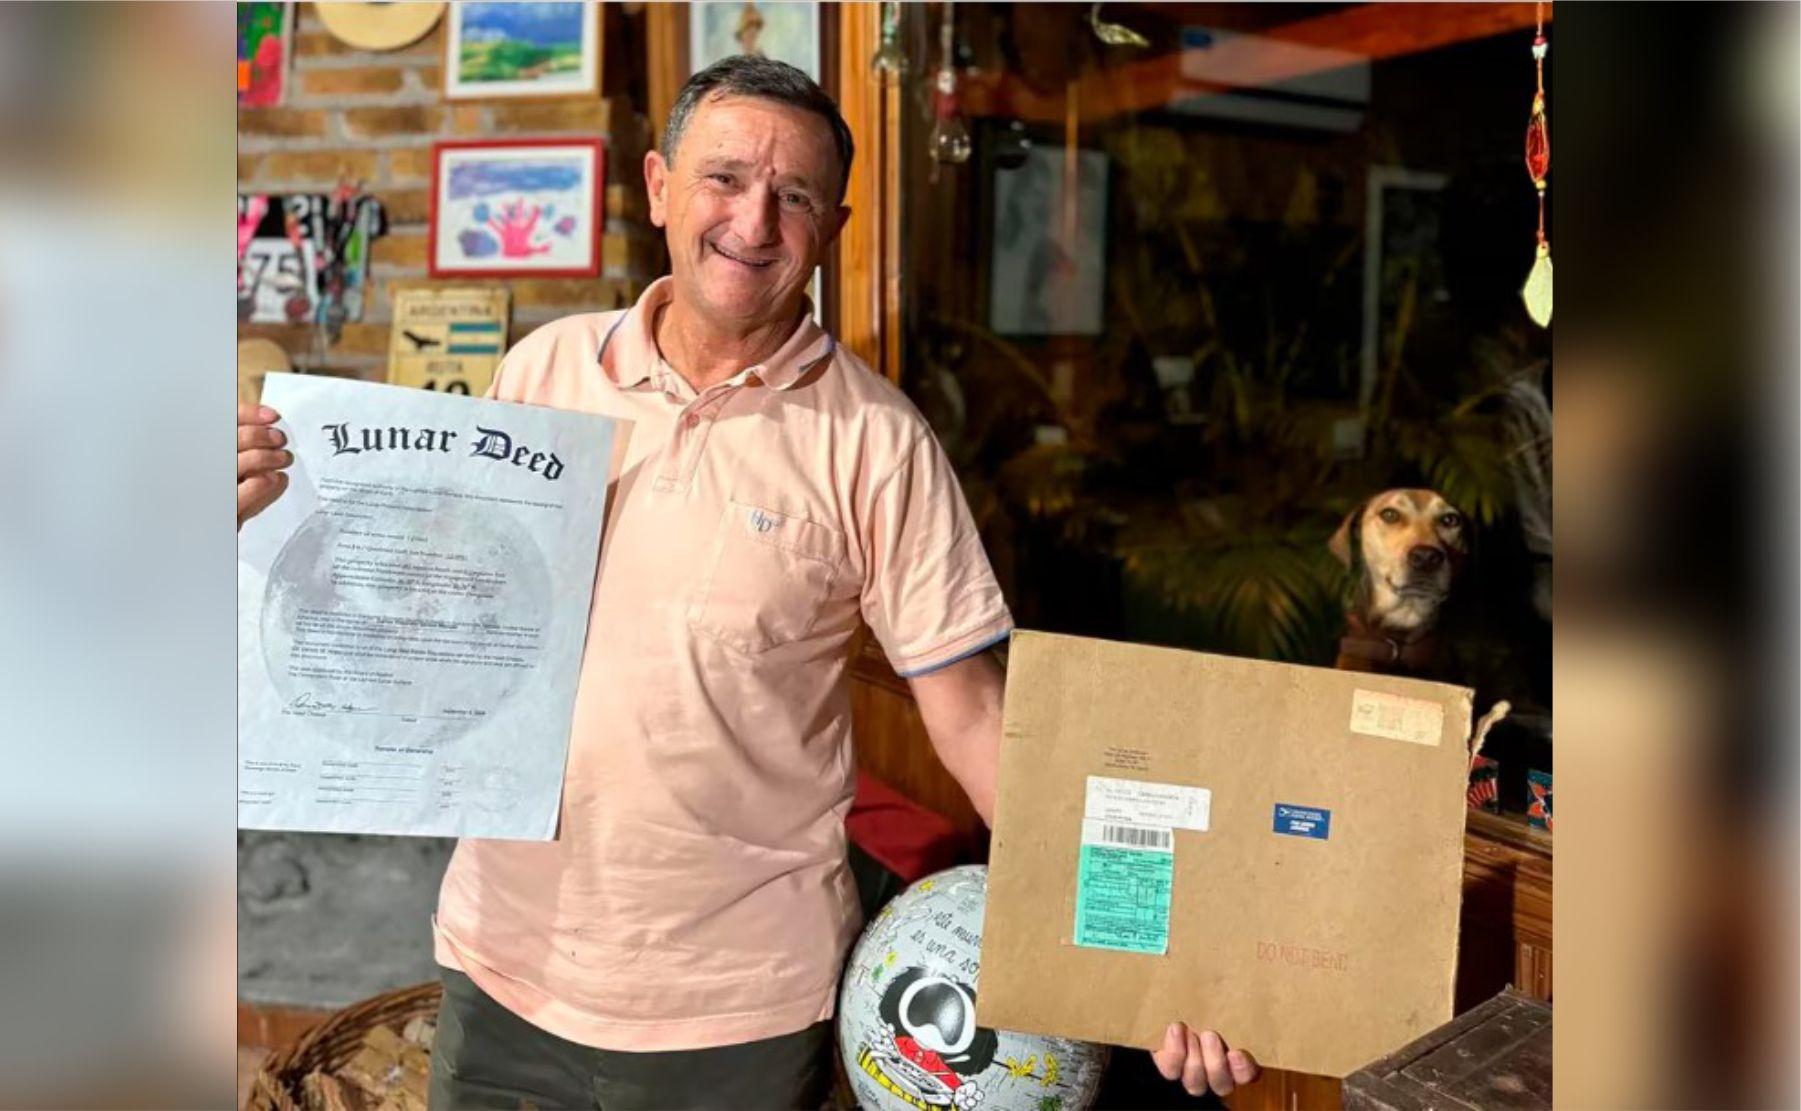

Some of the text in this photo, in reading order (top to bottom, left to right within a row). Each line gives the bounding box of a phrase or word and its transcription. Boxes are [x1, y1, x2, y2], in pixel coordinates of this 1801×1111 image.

[321, 421, 565, 481] Lunar Deed
[925, 938, 957, 964] una
[1256, 941, 1349, 972] DO NOT BEND
